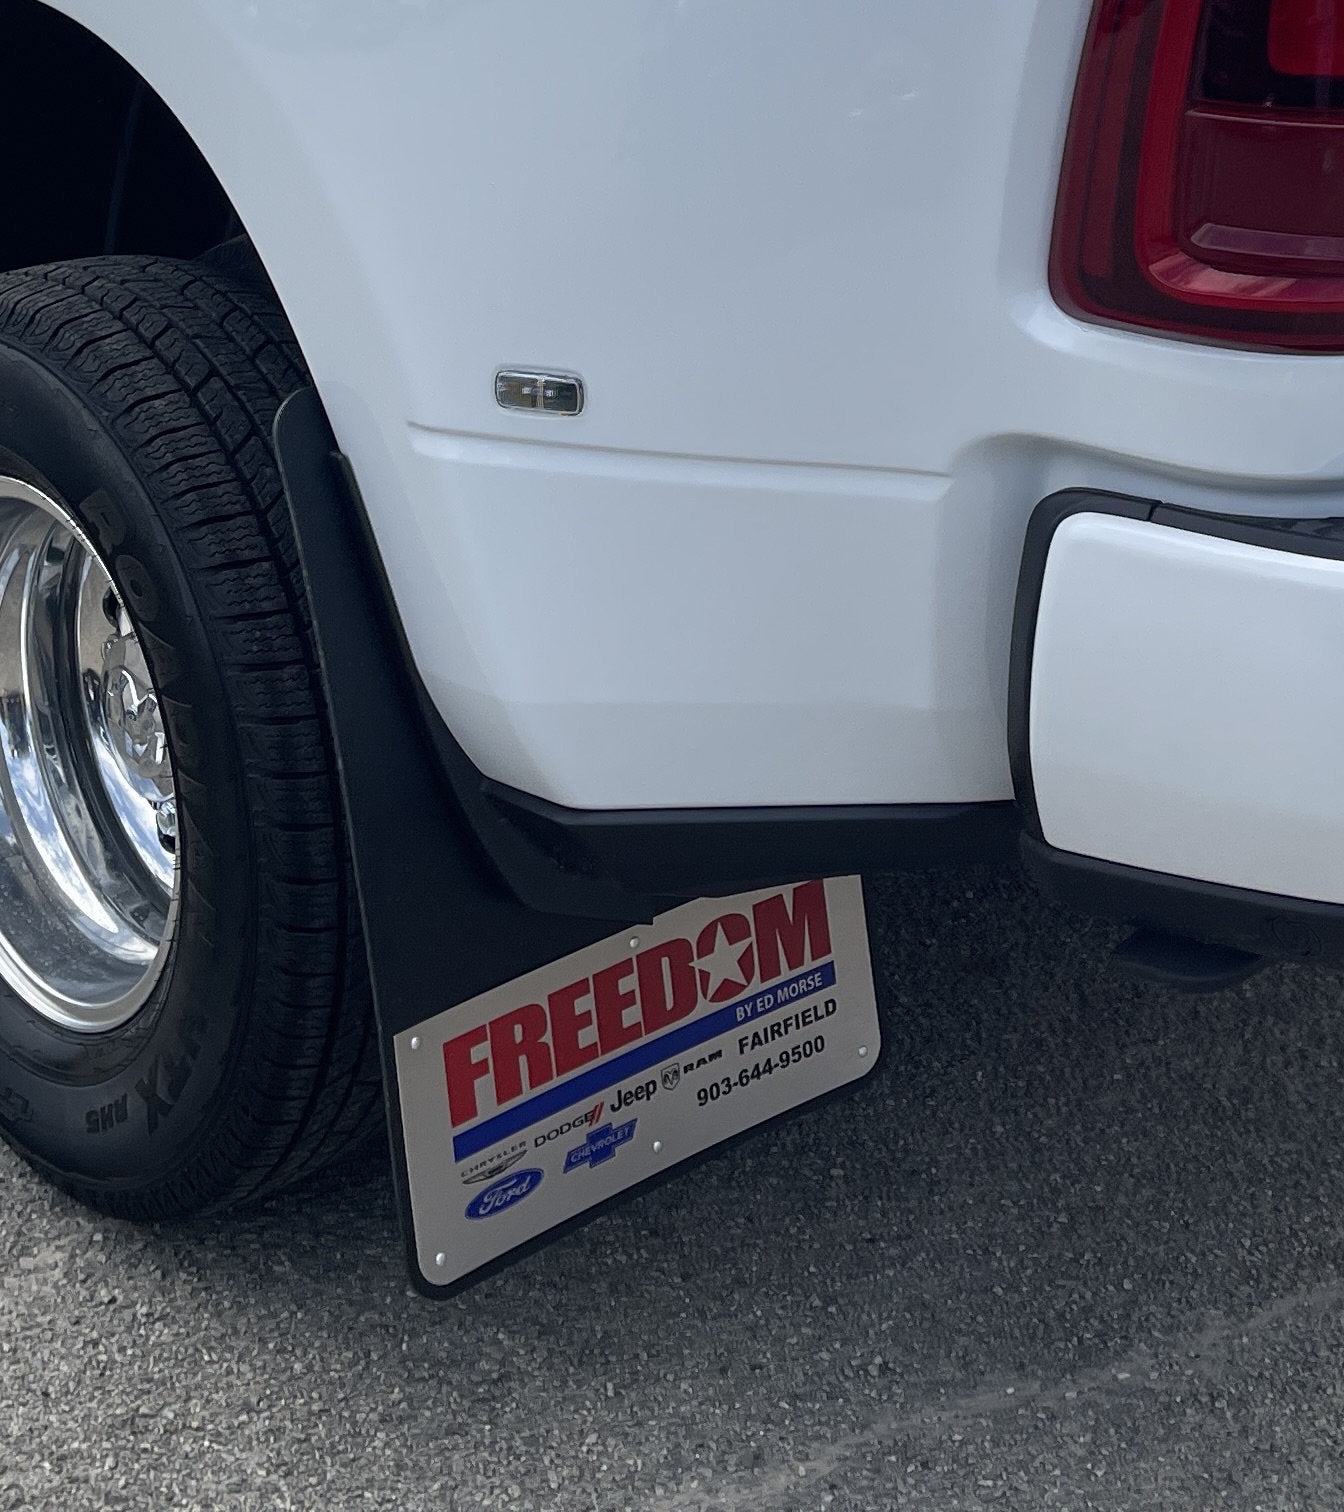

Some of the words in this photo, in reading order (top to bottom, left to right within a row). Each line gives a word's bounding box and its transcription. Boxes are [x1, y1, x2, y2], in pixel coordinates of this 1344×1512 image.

[443, 878, 832, 1128] FREEDOM
[736, 1002, 753, 1022] BY
[757, 995, 774, 1013] ED
[777, 972, 823, 1005] MORSE
[738, 998, 838, 1055] FAIRFIELD
[697, 1035, 826, 1107] 903-644-9500
[460, 1140, 527, 1178] CHRYSLER
[610, 1080, 657, 1113] Jeep
[683, 1050, 723, 1075] RAM
[479, 1175, 532, 1215] Ford
[570, 1126, 632, 1163] CHEVROLET
